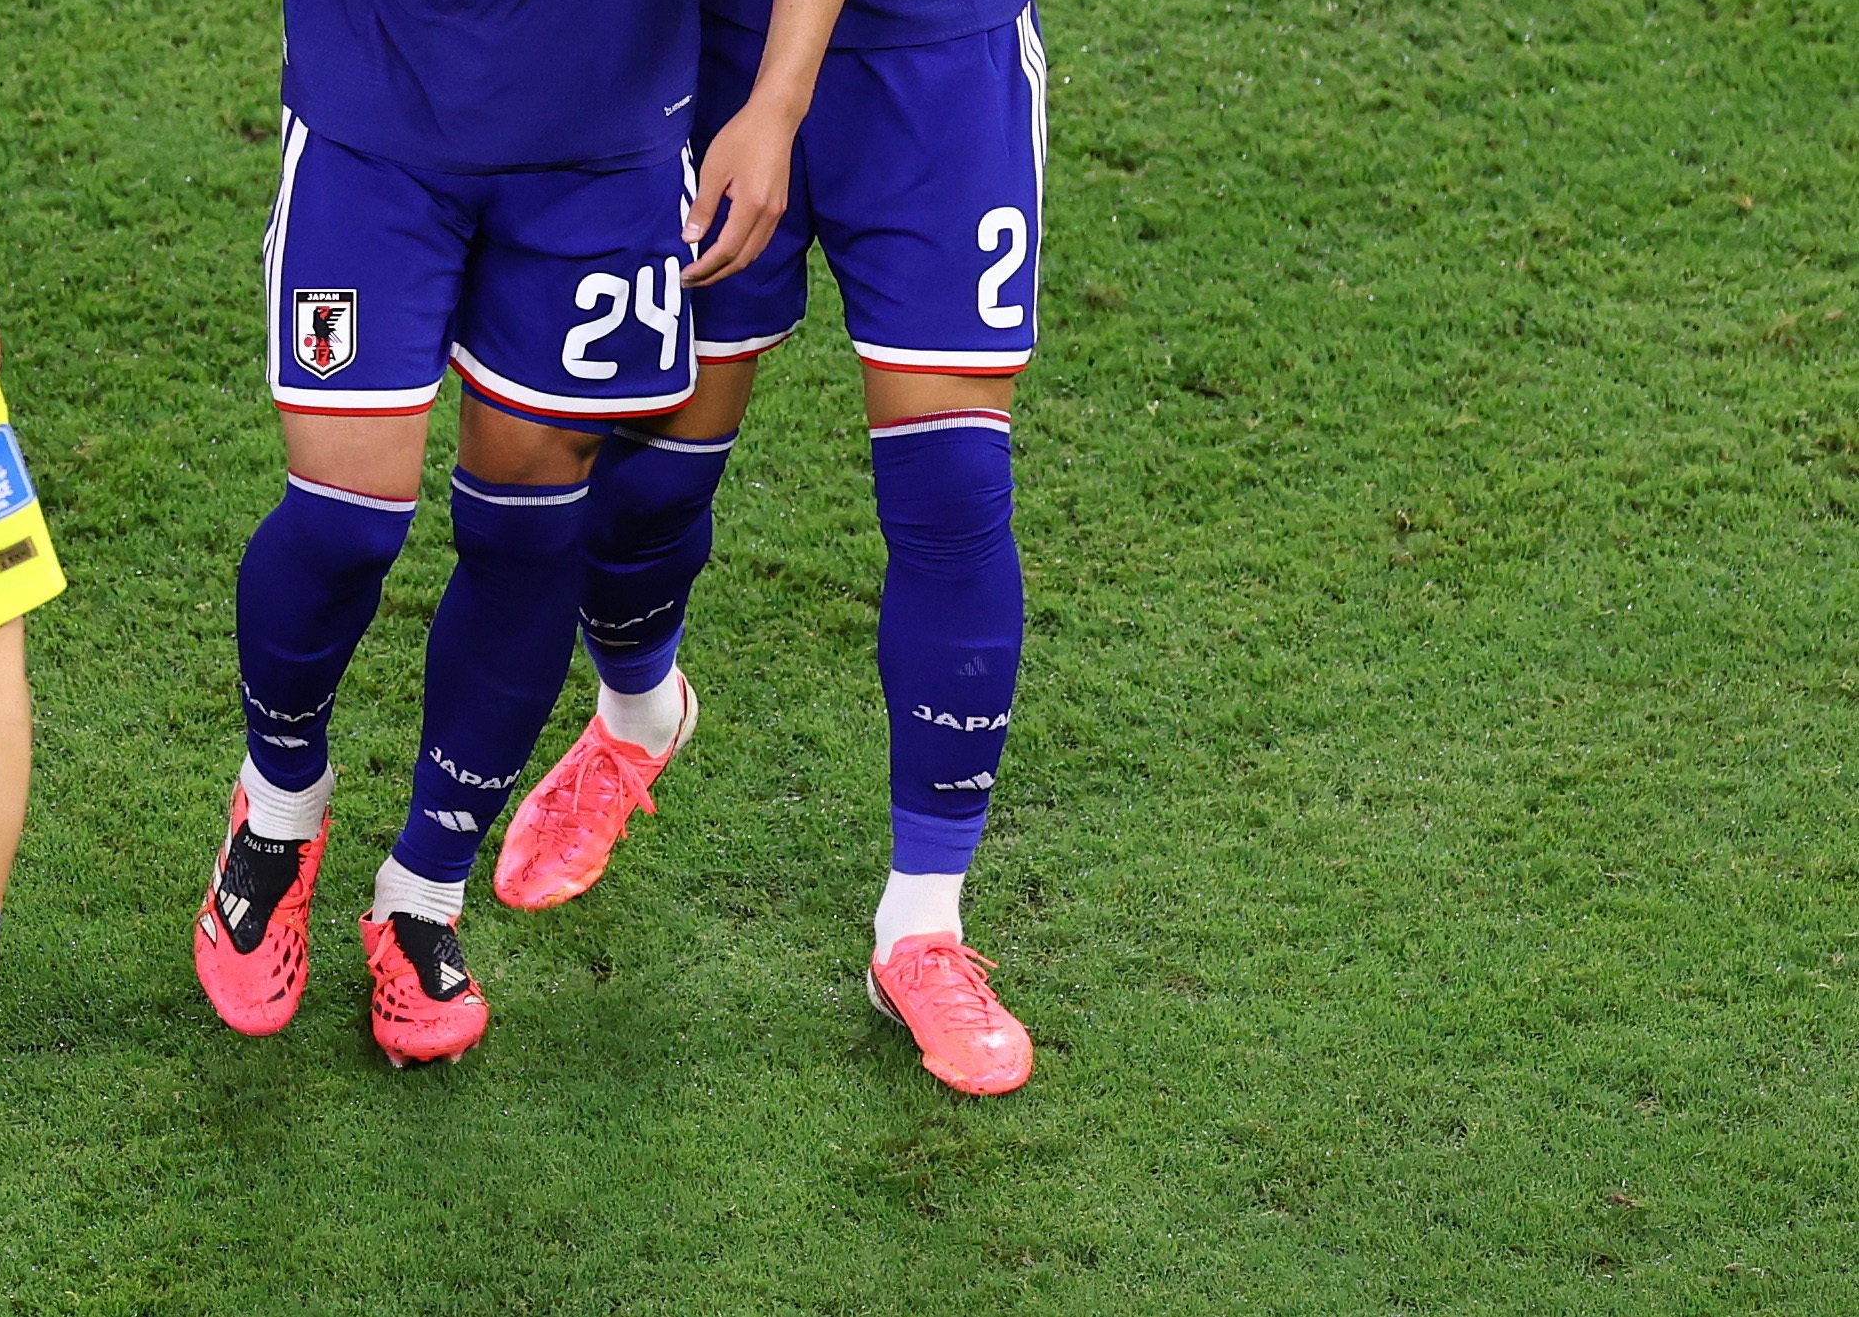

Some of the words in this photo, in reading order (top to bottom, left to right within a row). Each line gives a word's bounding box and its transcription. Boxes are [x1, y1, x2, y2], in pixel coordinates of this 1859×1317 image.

[977, 206, 1027, 329] 2
[307, 292, 340, 301] JAPAN
[561, 255, 682, 380] 24
[309, 348, 336, 362] JFA
[430, 746, 521, 790] JAPAN
